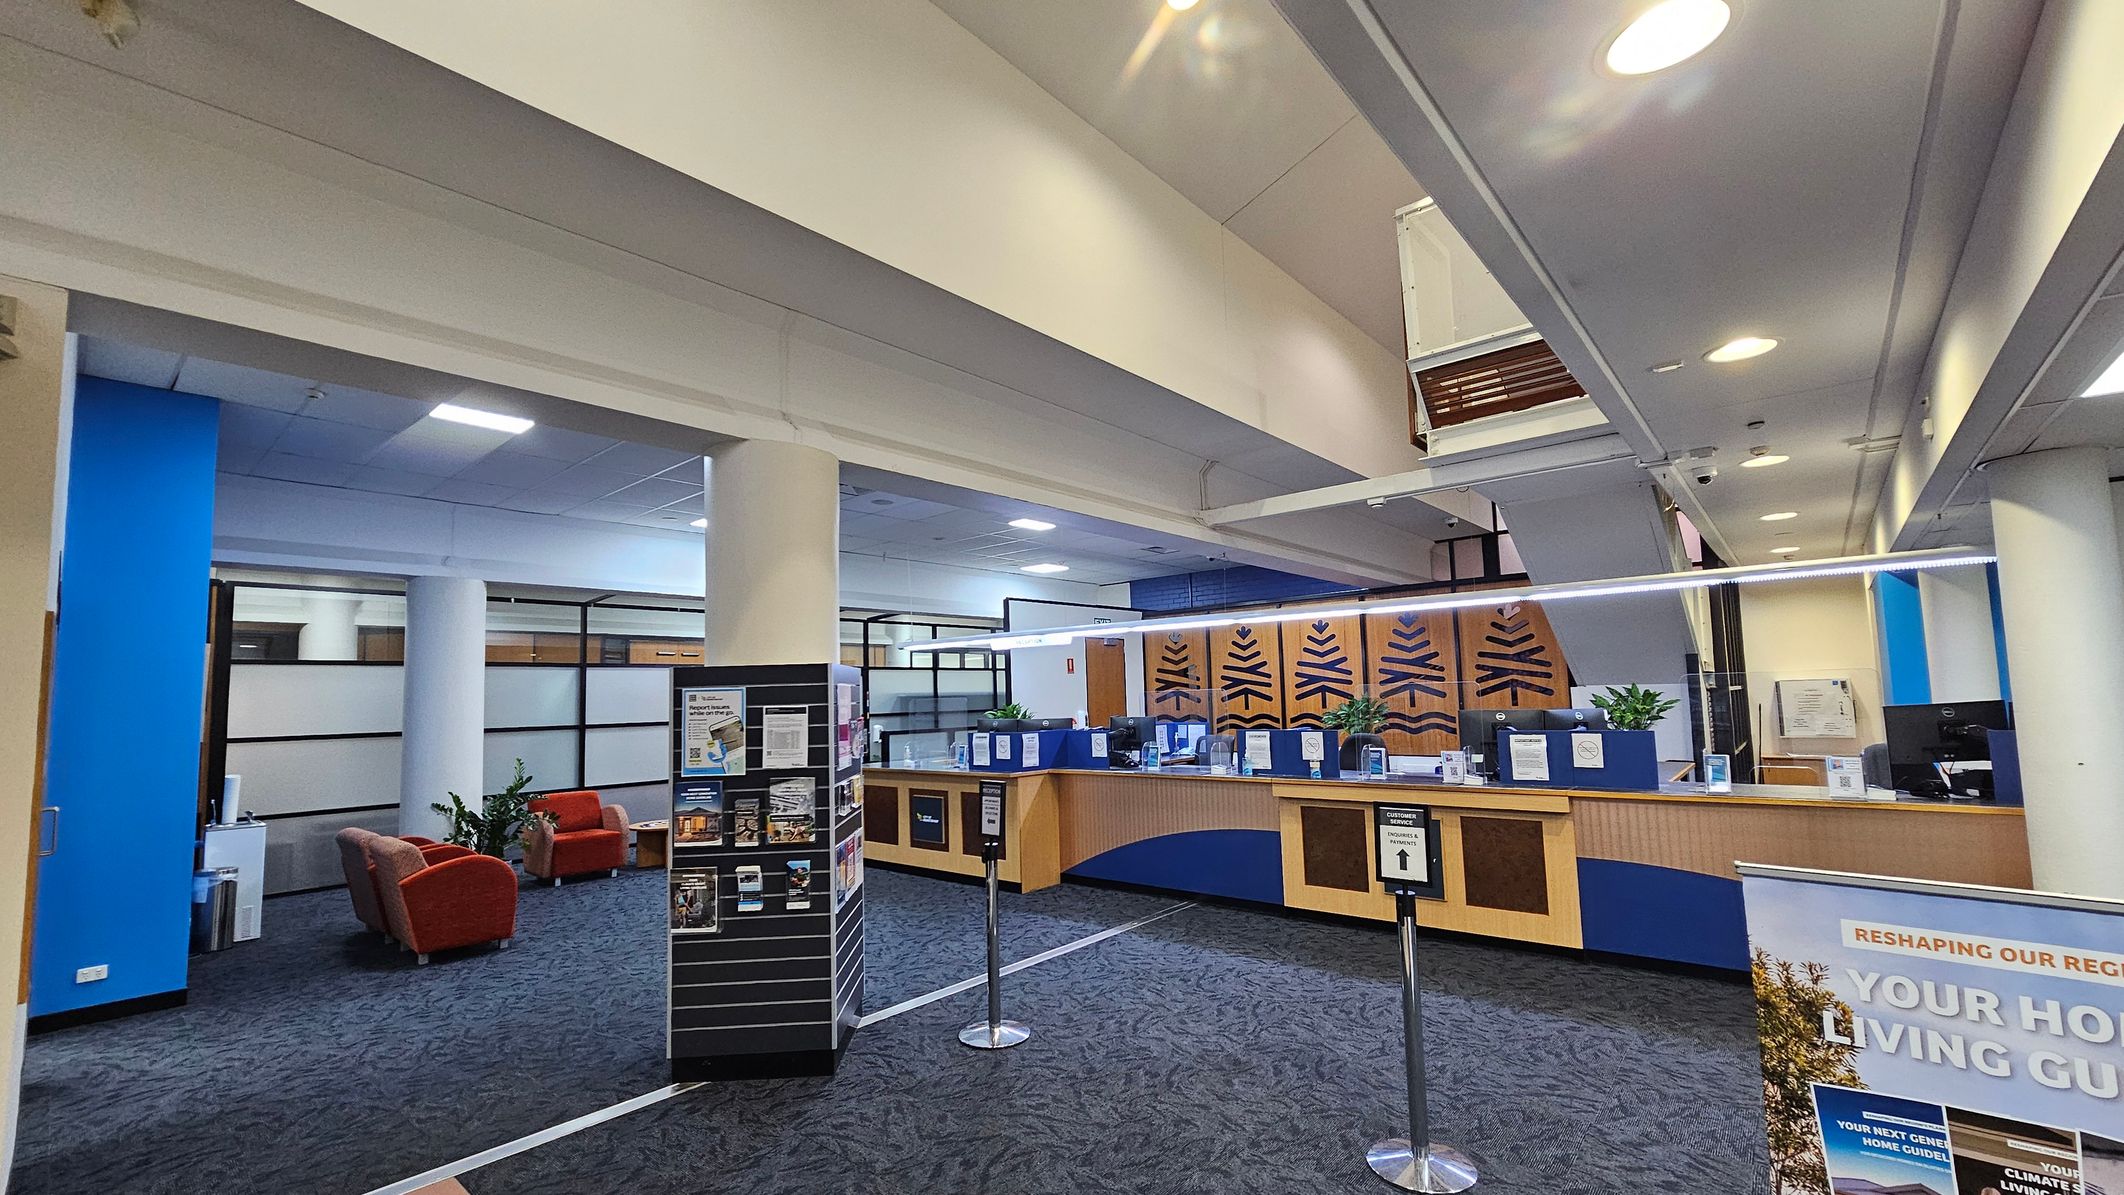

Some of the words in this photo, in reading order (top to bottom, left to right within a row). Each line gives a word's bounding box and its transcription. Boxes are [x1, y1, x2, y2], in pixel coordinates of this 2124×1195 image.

[1386, 811, 1417, 820] CUSTOMER
[1387, 831, 1413, 839] ENQUIRIES
[1389, 839, 1417, 847] PAYMENTS
[1855, 927, 1992, 960] RESHAPING
[1999, 946, 2057, 969] OUR
[1845, 968, 2005, 1027] YOUR
[1821, 1010, 2012, 1079] LIVING
[1836, 1120, 1872, 1134] YOUR
[1873, 1126, 1907, 1141] NEXT
[1862, 1137, 1901, 1152] HOME
[2004, 1168, 2071, 1191] CLIMATE
